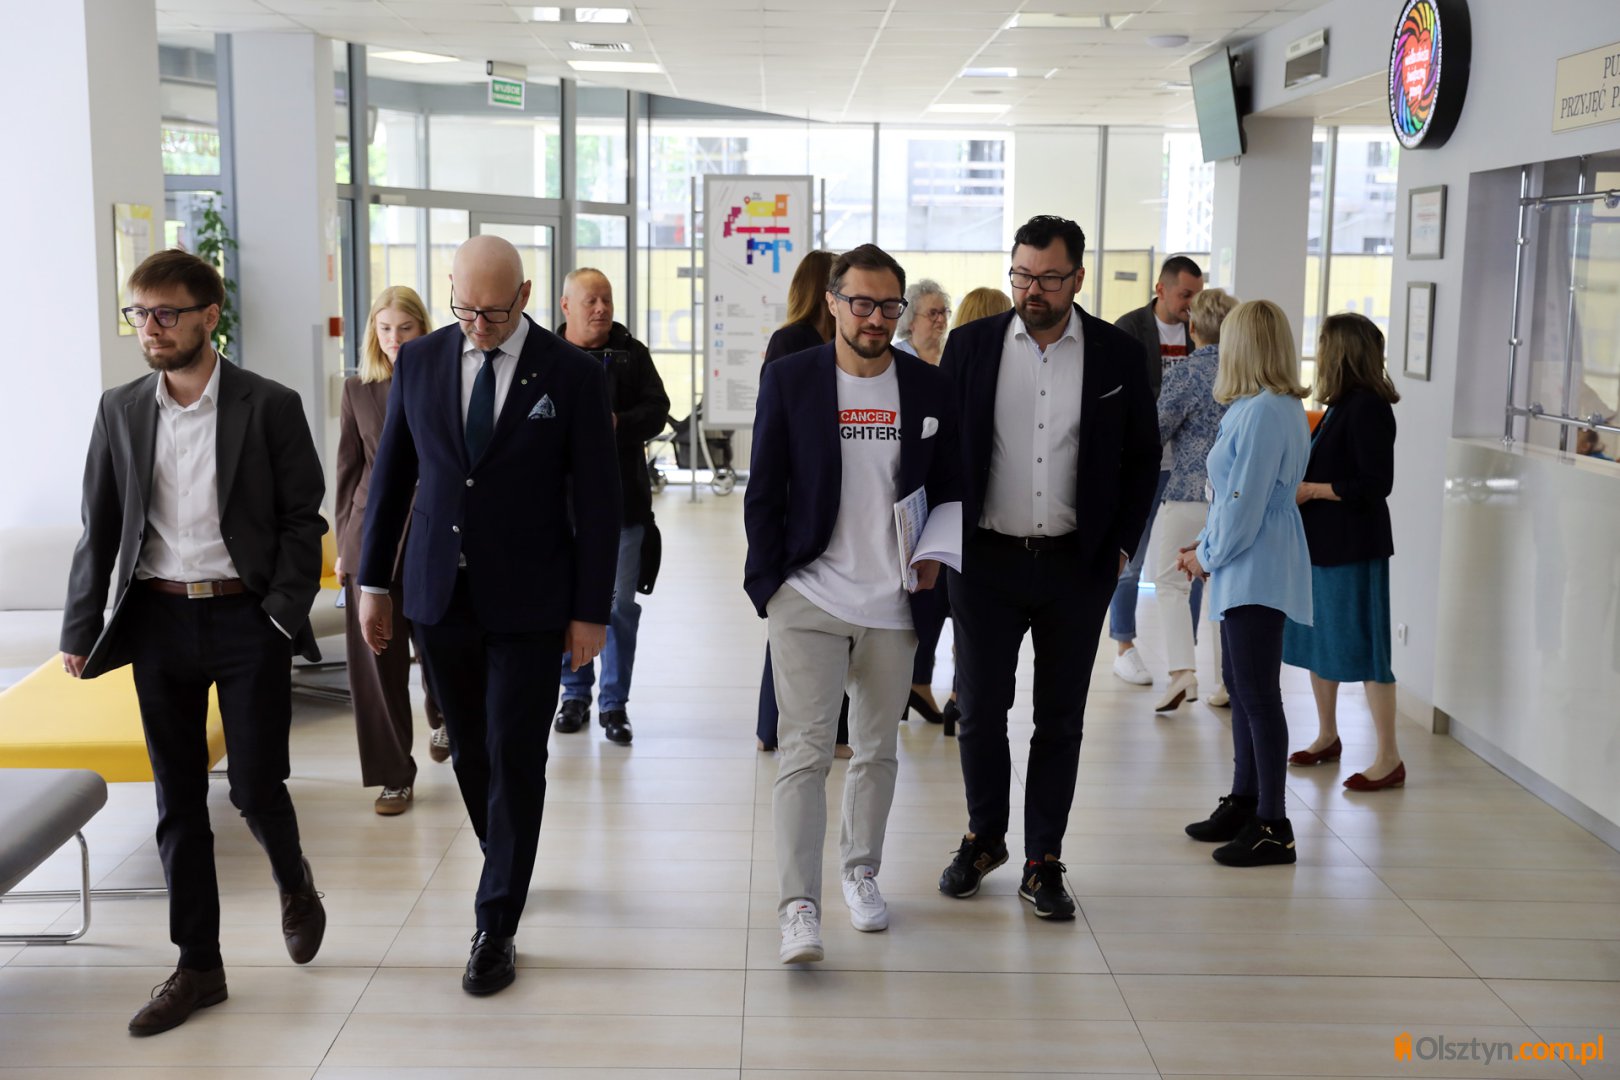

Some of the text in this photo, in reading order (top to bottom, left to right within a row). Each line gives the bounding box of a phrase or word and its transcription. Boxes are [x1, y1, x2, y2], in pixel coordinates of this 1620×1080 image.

[1560, 83, 1620, 118] PRZYJĘĆ P
[840, 411, 892, 422] CANCER
